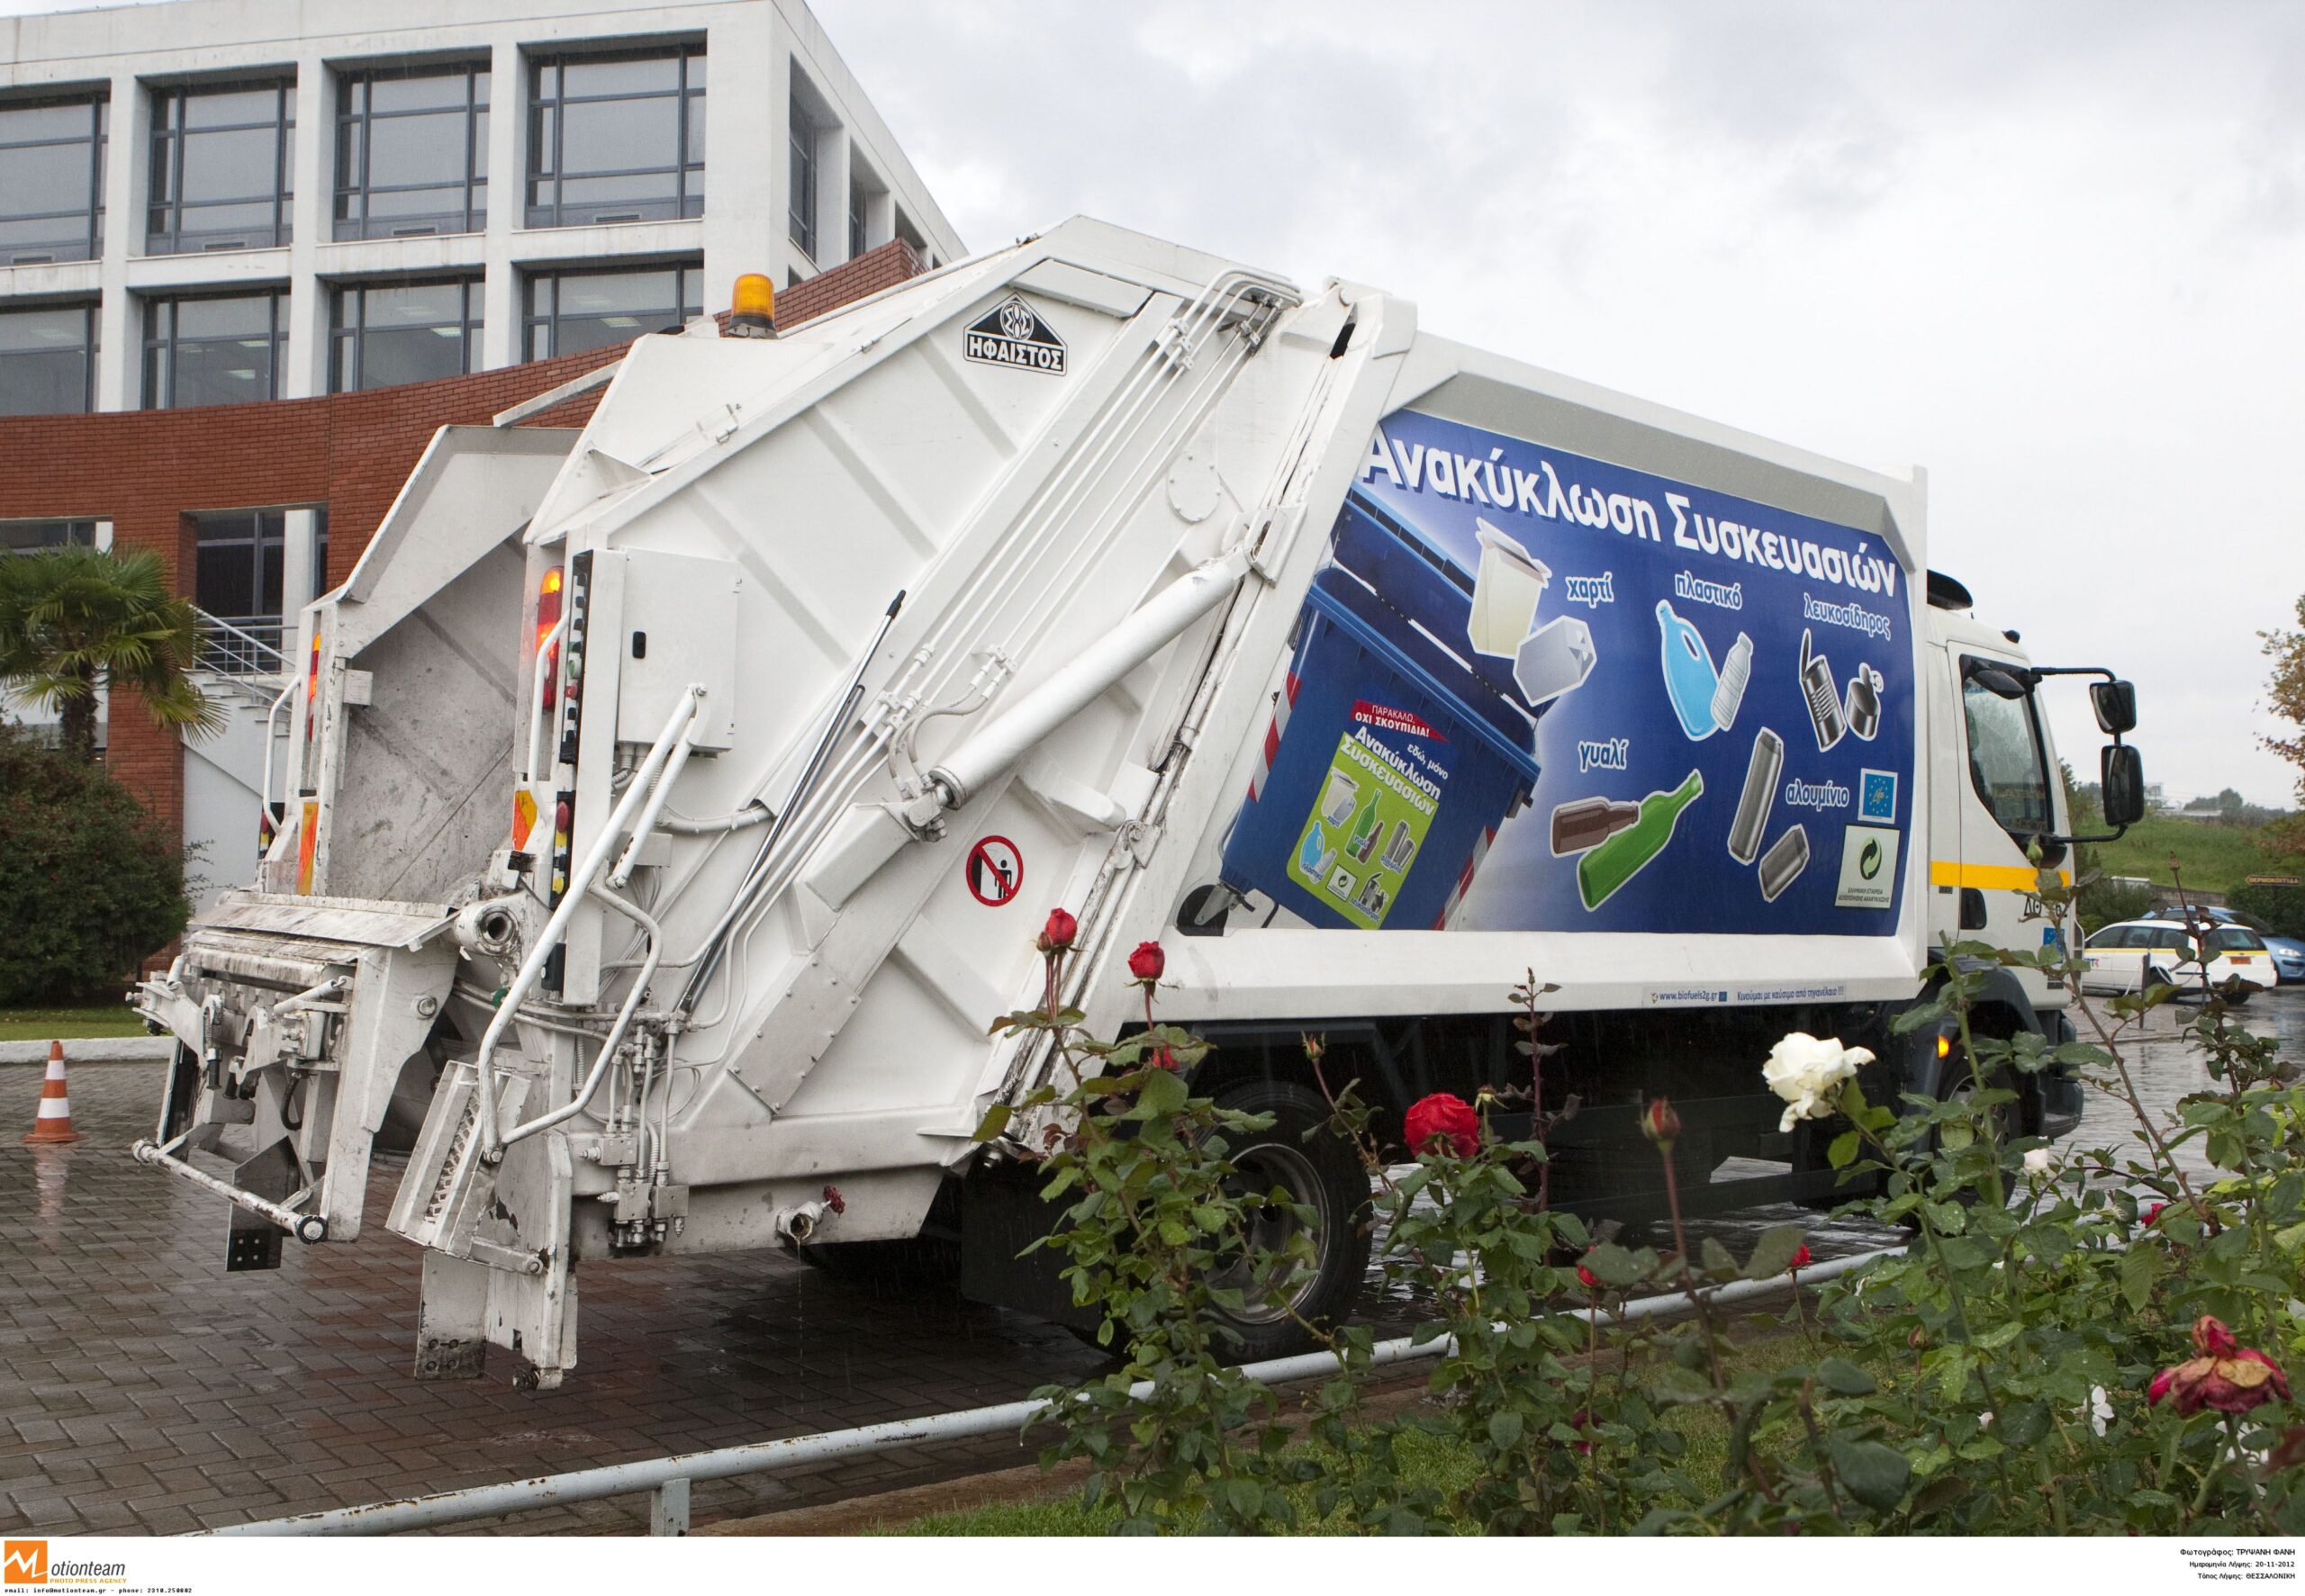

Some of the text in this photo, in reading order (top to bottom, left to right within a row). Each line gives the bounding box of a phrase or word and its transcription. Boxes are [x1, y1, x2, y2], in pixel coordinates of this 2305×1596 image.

[969, 336, 1062, 370] ΗΦΑΙΣΤΟΣ
[1358, 423, 1896, 597] Ανακύκλωση Συσκευασιών
[1566, 572, 1614, 609] χαρτί
[1675, 570, 1742, 610] πλαστικό
[1803, 592, 1891, 641] λευκοσίδηρος
[1355, 712, 1430, 737] ΟΧΙ ΣΚΟΥΠΙΔΙΑ!
[1371, 705, 1415, 724] ΠΑΡΑΚΑΛΩ,
[1354, 726, 1442, 800] Ανακύκλωση
[1406, 744, 1449, 780] εδώ, μόνο
[1578, 738, 1629, 772] γυαλί
[1340, 735, 1435, 816] Συσκευασιών
[1785, 778, 1849, 812] αλουμίνιο
[1659, 990, 1718, 1001] www.biofuels2g.gr
